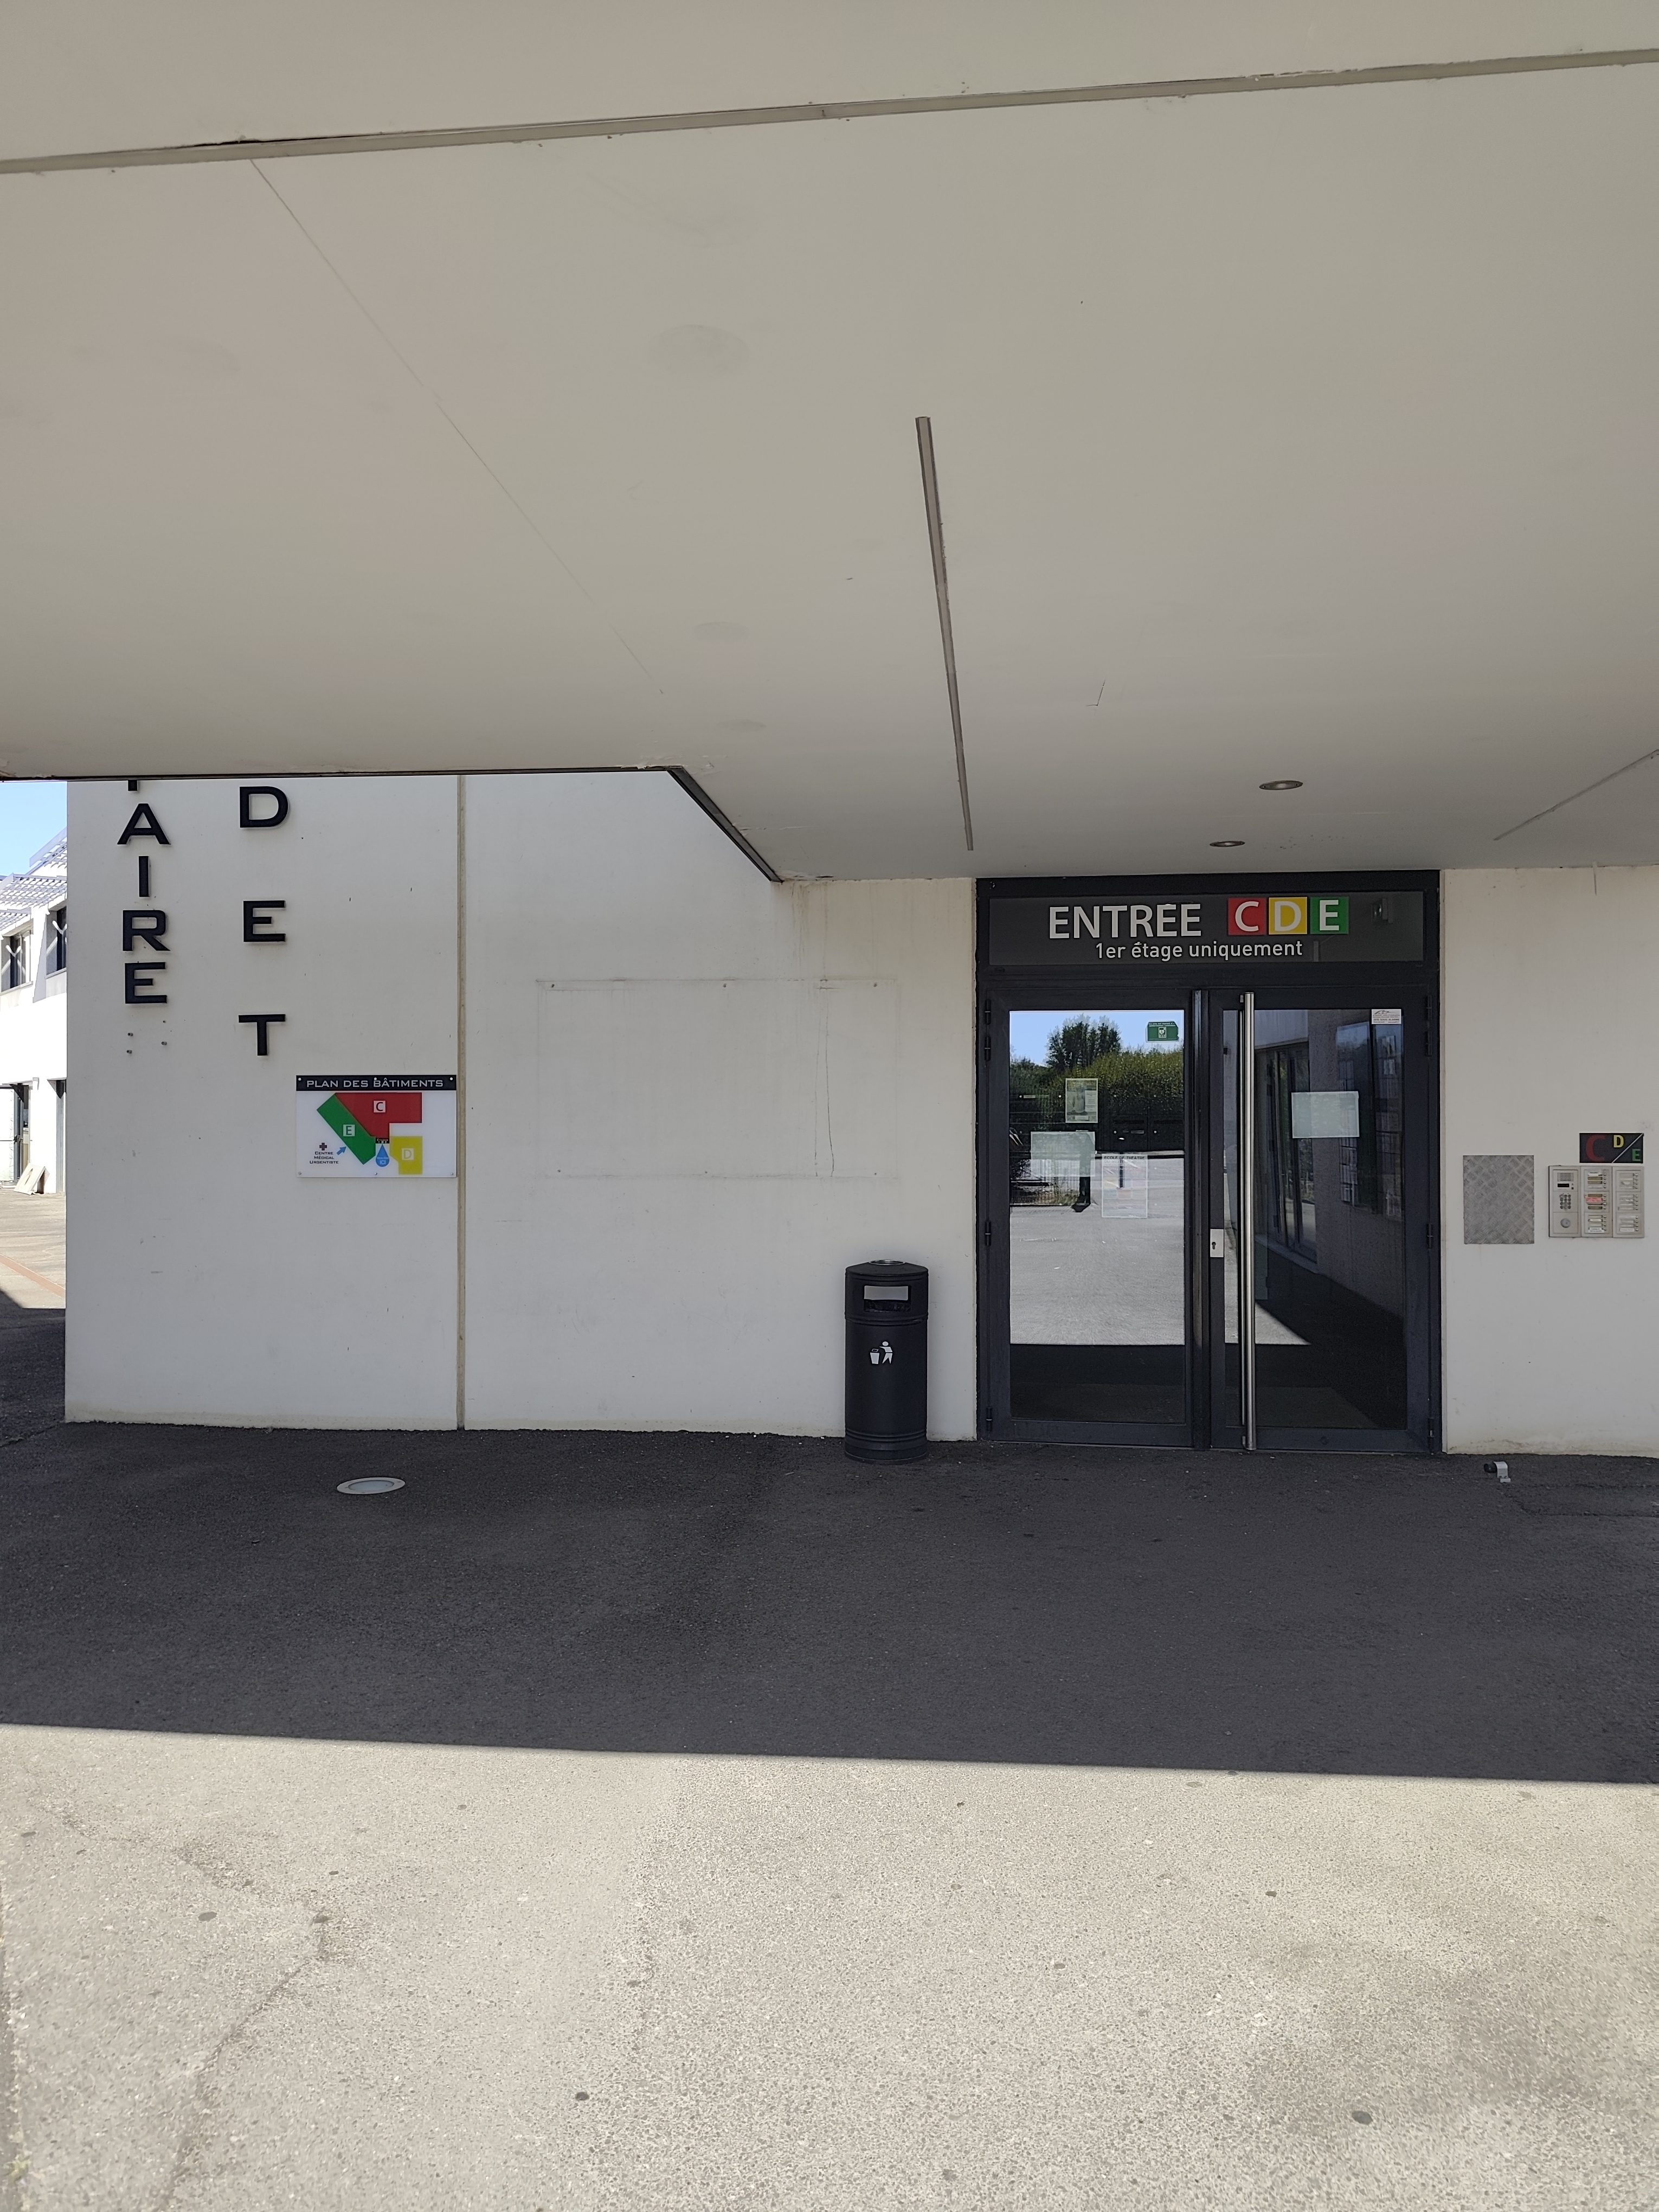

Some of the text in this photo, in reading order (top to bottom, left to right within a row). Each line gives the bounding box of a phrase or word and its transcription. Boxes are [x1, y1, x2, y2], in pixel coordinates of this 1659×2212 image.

[1049, 904, 1201, 938] ENTREE
[1096, 941, 1303, 961] 1er étage uniquement
[373, 1078, 443, 1087] BÂTIMENTS
[376, 1102, 383, 1111] C
[345, 1126, 352, 1135] E
[1585, 1135, 1641, 1162] C D E
[403, 1149, 412, 1159] D
